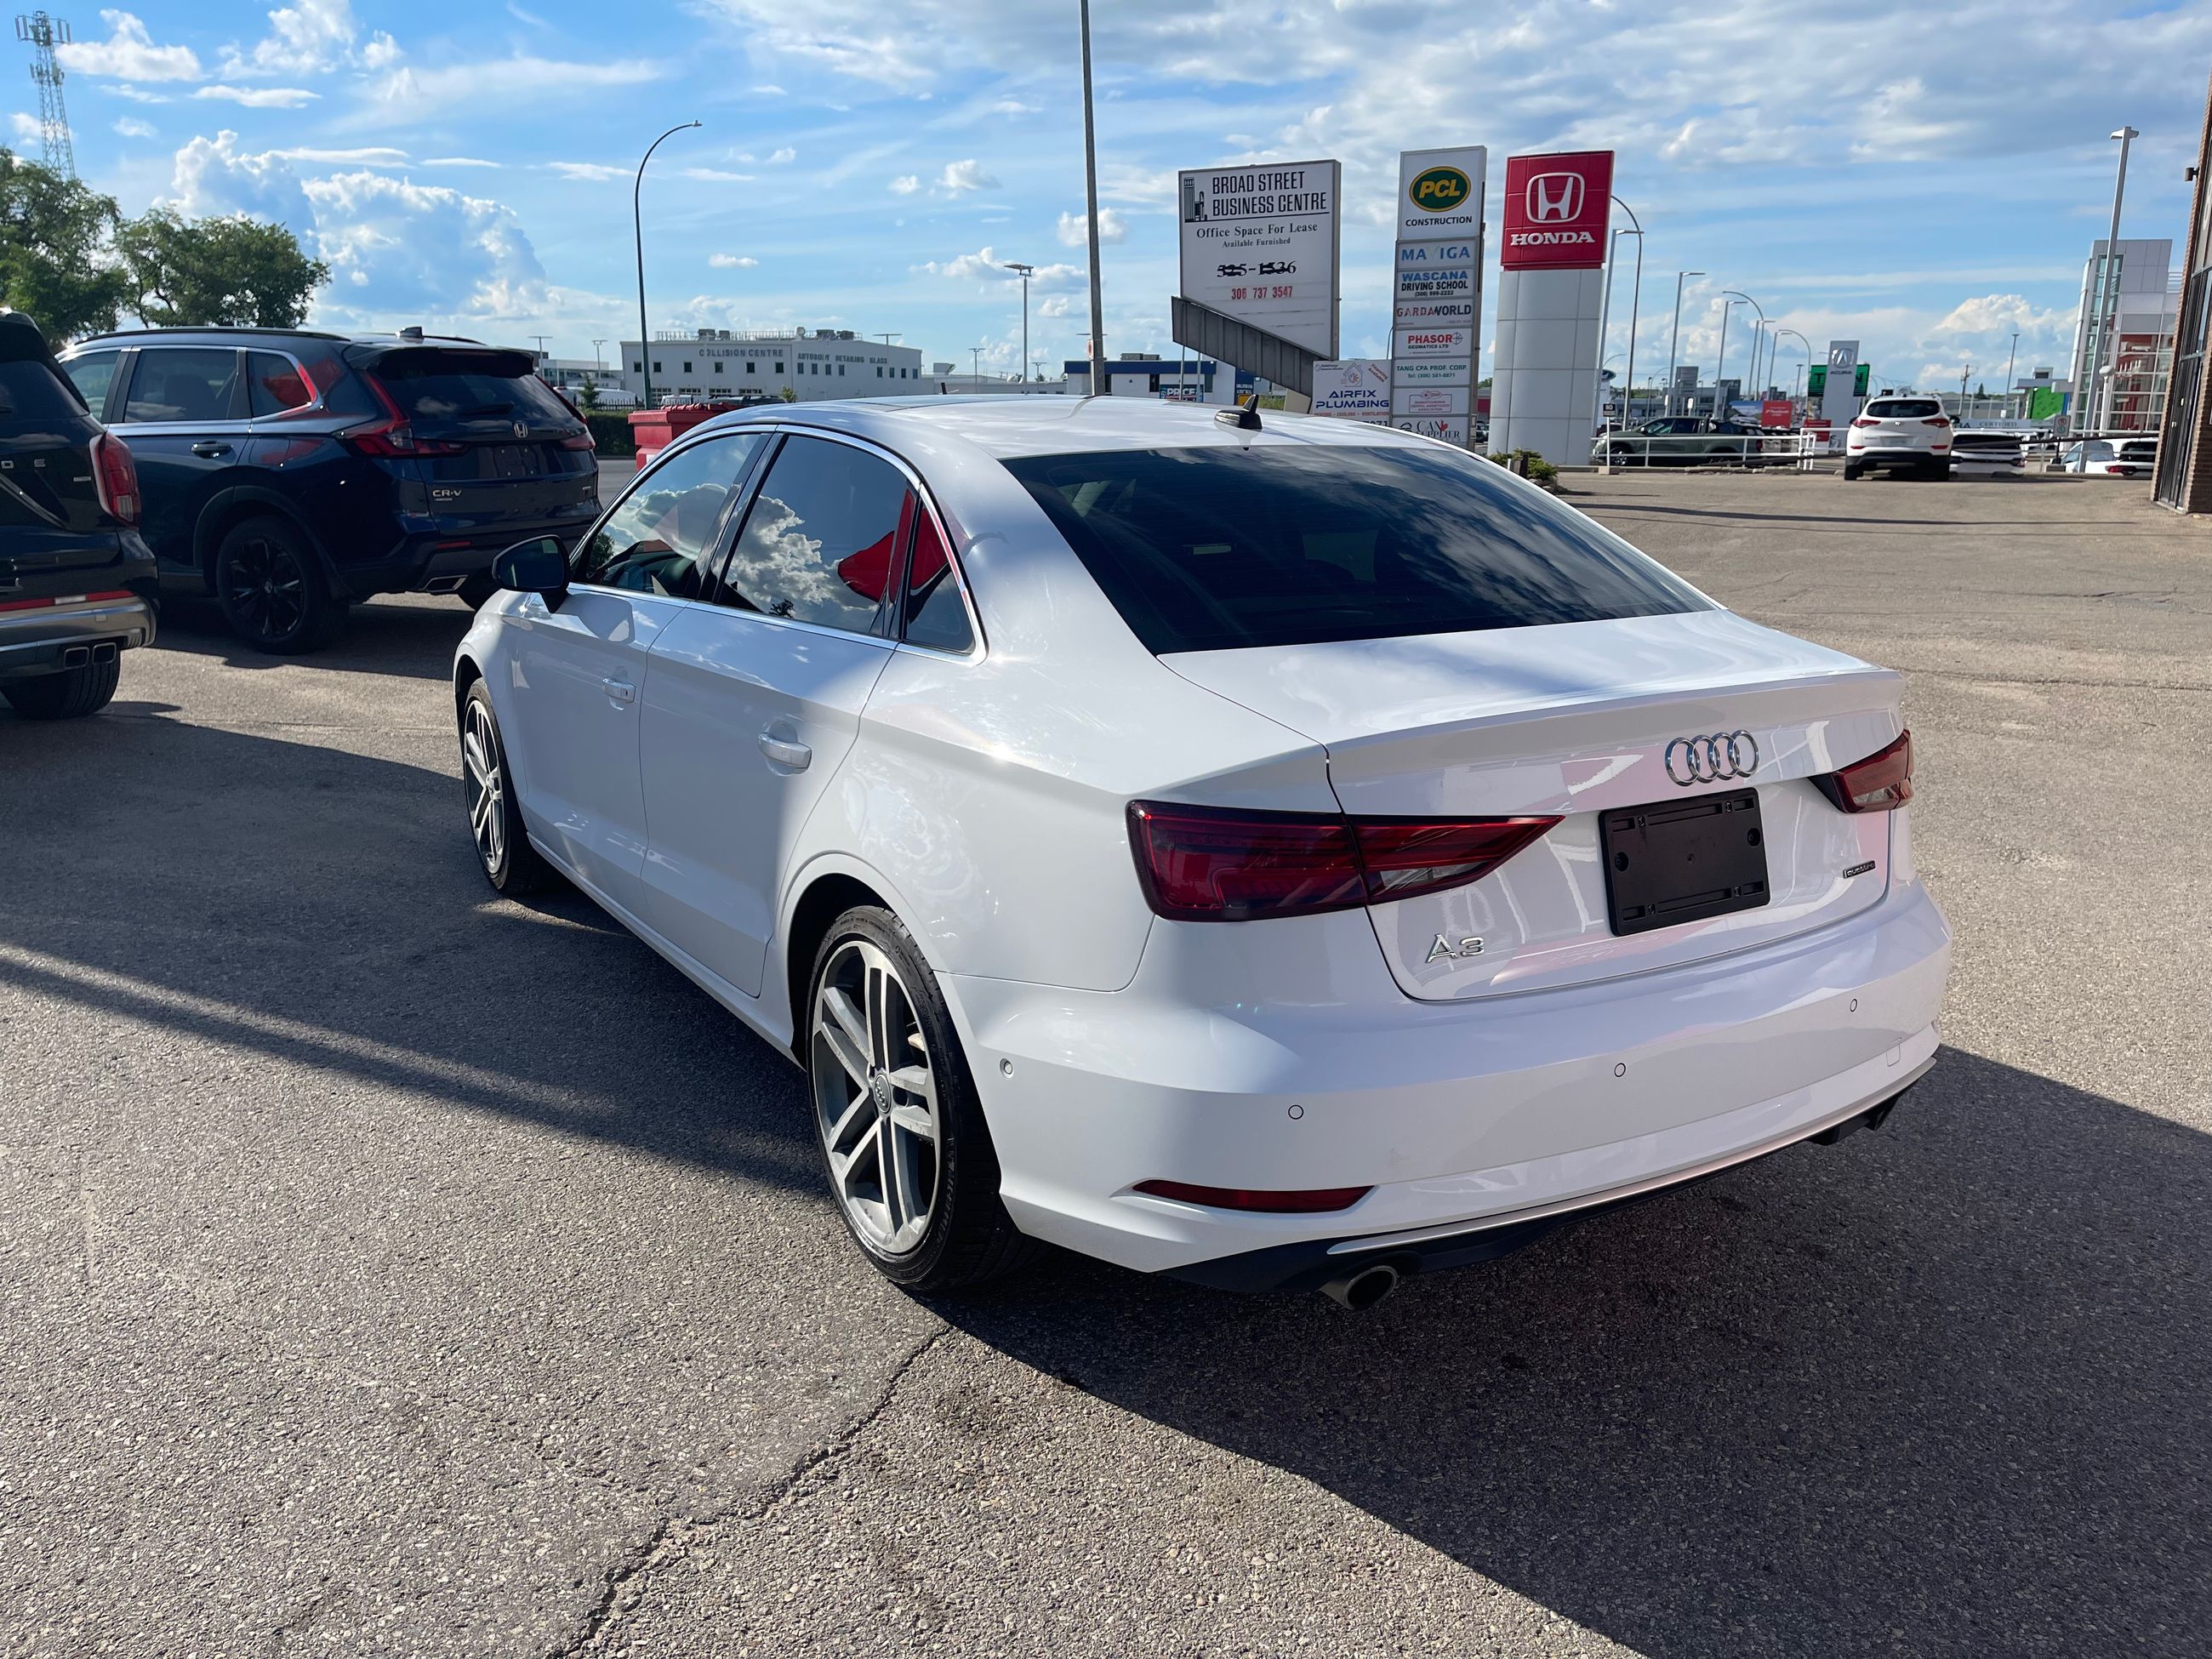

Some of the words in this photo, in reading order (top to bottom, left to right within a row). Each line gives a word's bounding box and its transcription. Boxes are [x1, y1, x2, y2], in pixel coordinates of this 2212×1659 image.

[1212, 174, 1254, 194] BROAD
[1258, 171, 1305, 191] STREET
[1418, 179, 1461, 198] PCL
[1212, 196, 1274, 216] BUSINESS
[1278, 192, 1327, 213] CENTRE
[1405, 216, 1473, 226] CONSTRUCTION
[1196, 227, 1230, 238] Office
[1234, 225, 1263, 238] Space
[1268, 224, 1285, 234] For
[1290, 222, 1318, 233] Lease
[1222, 238, 1254, 248] Available
[1257, 237, 1291, 246] Furnished
[1510, 231, 1596, 246] HONDA
[1402, 271, 1468, 282] WASCANA
[1401, 282, 1434, 292] DRIVING
[1436, 280, 1468, 290] SCHOOL
[1231, 288, 1247, 299] 306
[1253, 287, 1268, 299] 737
[1272, 286, 1293, 298] 3547
[1396, 305, 1472, 317] GARDAWORLD
[1408, 334, 1453, 344] PHASOR
[698, 349, 745, 357] COLLISION
[748, 349, 784, 357] CENTRE
[1329, 390, 1377, 398] AIRFIX
[1316, 400, 1389, 408] PLUMBING
[1424, 933, 1485, 964] A3
